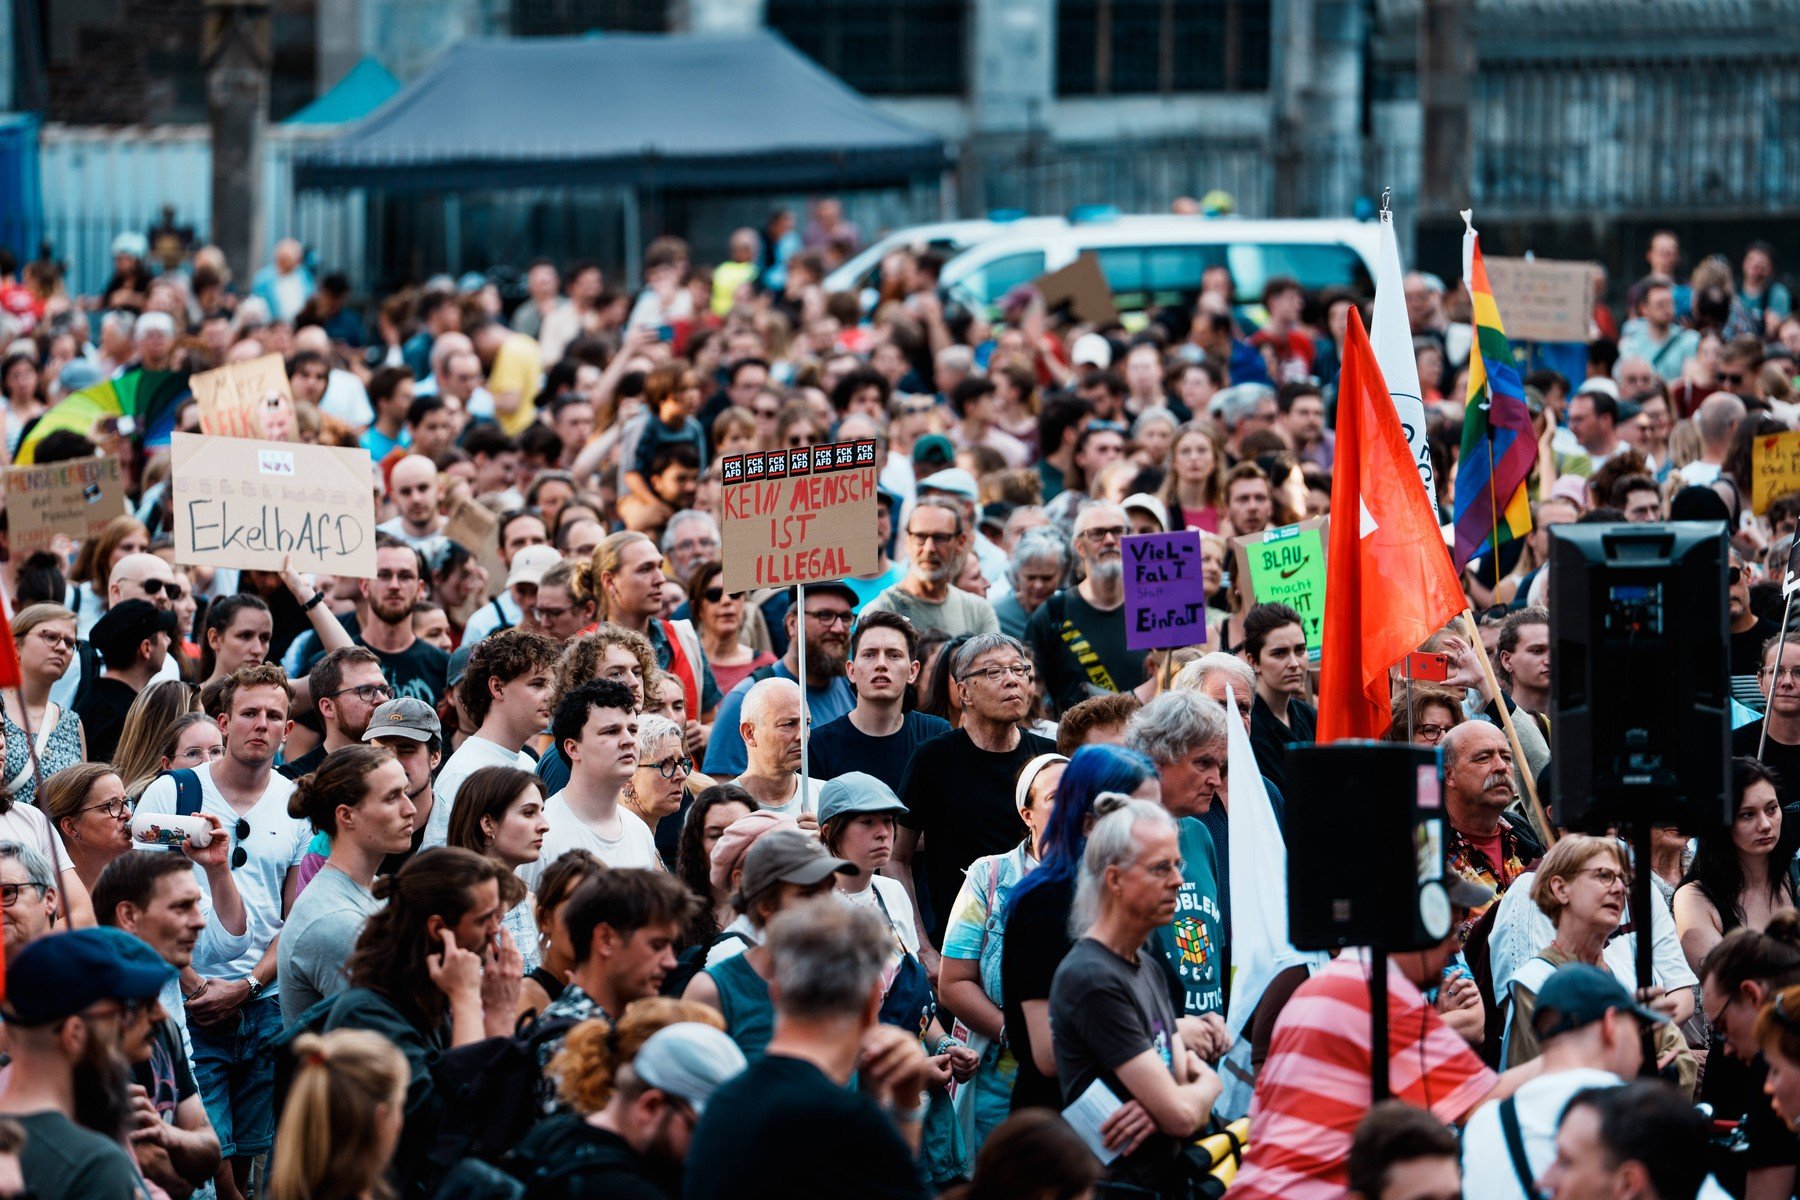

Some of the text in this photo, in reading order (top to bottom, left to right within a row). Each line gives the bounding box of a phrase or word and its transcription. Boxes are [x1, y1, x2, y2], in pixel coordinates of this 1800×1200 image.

[837, 447, 852, 456] FCK
[857, 444, 873, 454] FCK
[792, 452, 808, 462] FCK
[815, 450, 831, 459] FCK
[857, 452, 873, 461] AFD
[747, 457, 763, 466] FCK
[769, 456, 785, 465] FCK
[815, 458, 831, 466] AFD
[837, 455, 852, 464] AFD
[725, 461, 741, 470] FCK
[769, 464, 785, 473] AFD
[792, 461, 808, 470] AFD
[725, 469, 741, 478] AFD
[747, 466, 763, 475] AFD
[724, 468, 874, 520] KEIN MENSCH
[189, 499, 363, 562] EkelhAfD
[771, 513, 817, 549] IST
[1262, 545, 1301, 571] BLAU
[755, 547, 852, 585] ILLEGAL
[1271, 578, 1312, 596] macht
